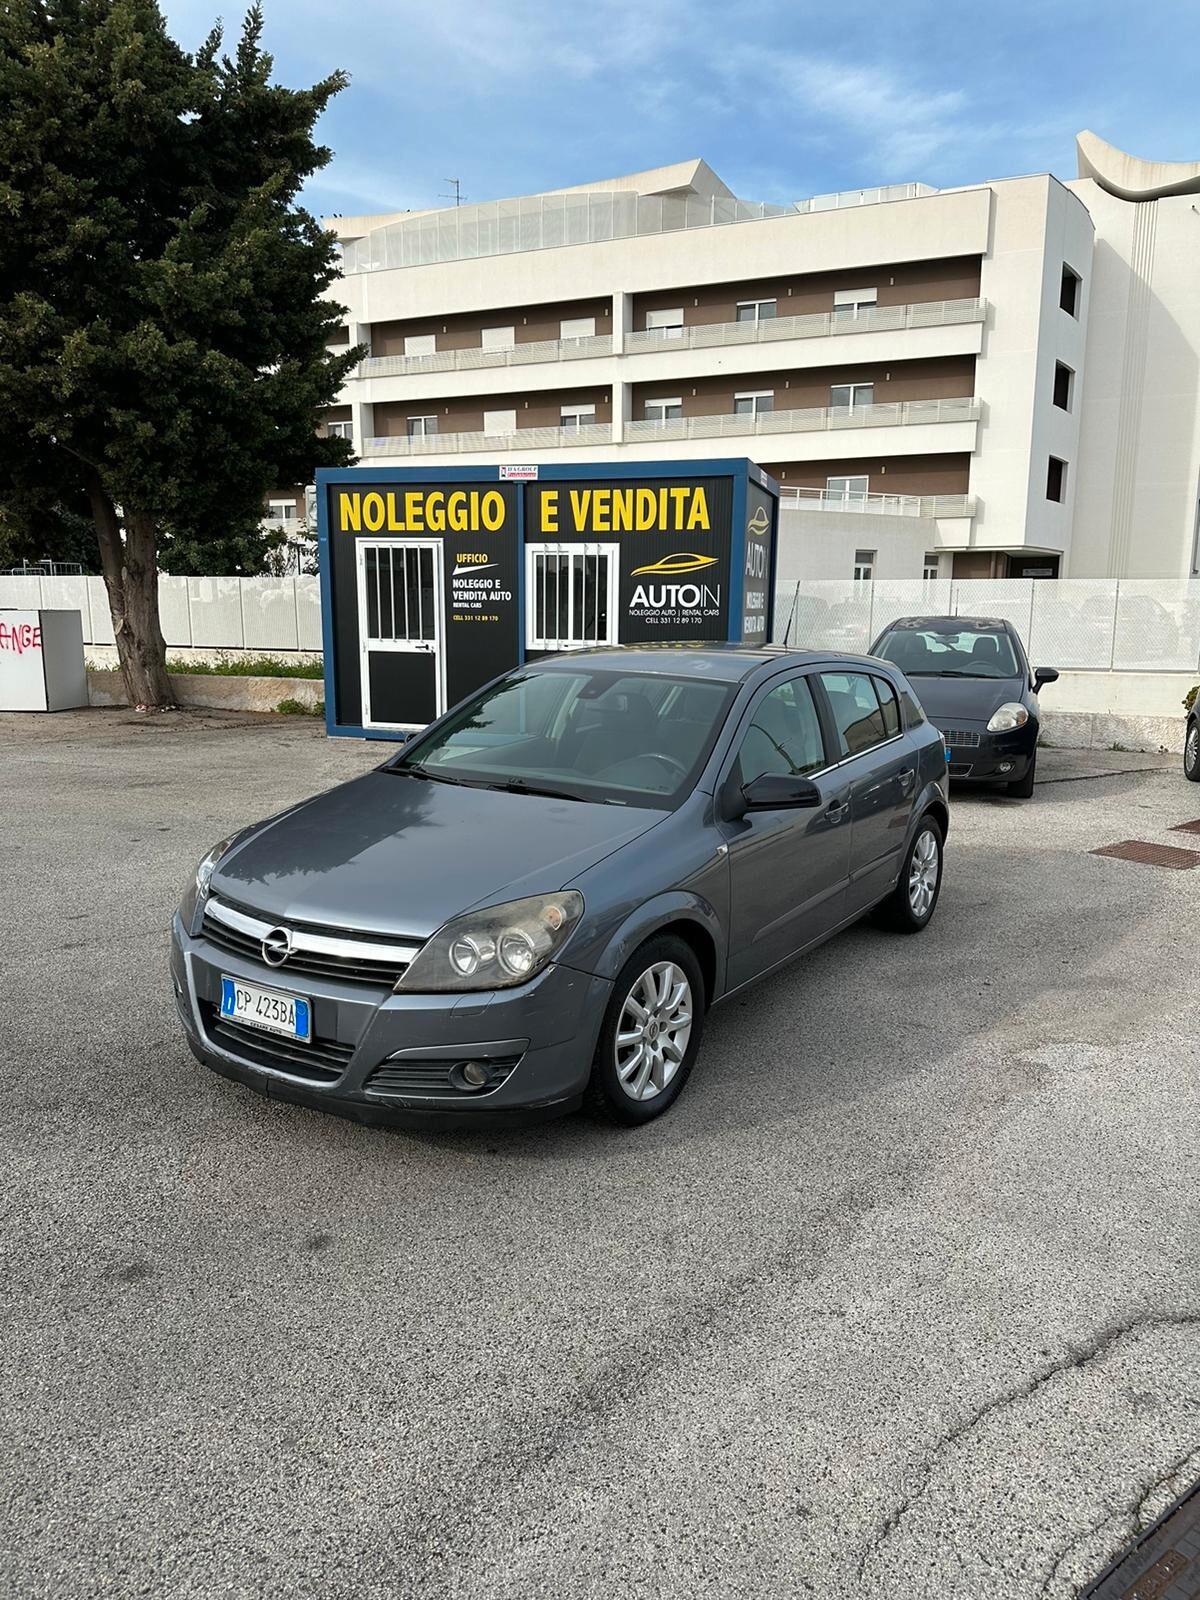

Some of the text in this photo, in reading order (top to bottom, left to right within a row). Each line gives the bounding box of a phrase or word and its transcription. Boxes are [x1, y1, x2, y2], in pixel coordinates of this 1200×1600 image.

[339, 487, 711, 532] NOLEGGIO E VENDITA
[456, 553, 488, 563] UFFICIO
[453, 579, 501, 589] NOLEGGIO E
[453, 591, 512, 601] VENDITA AUTO
[629, 584, 720, 608] AUTOIN
[236, 989, 252, 1012] CP
[255, 995, 296, 1026] 423BA
